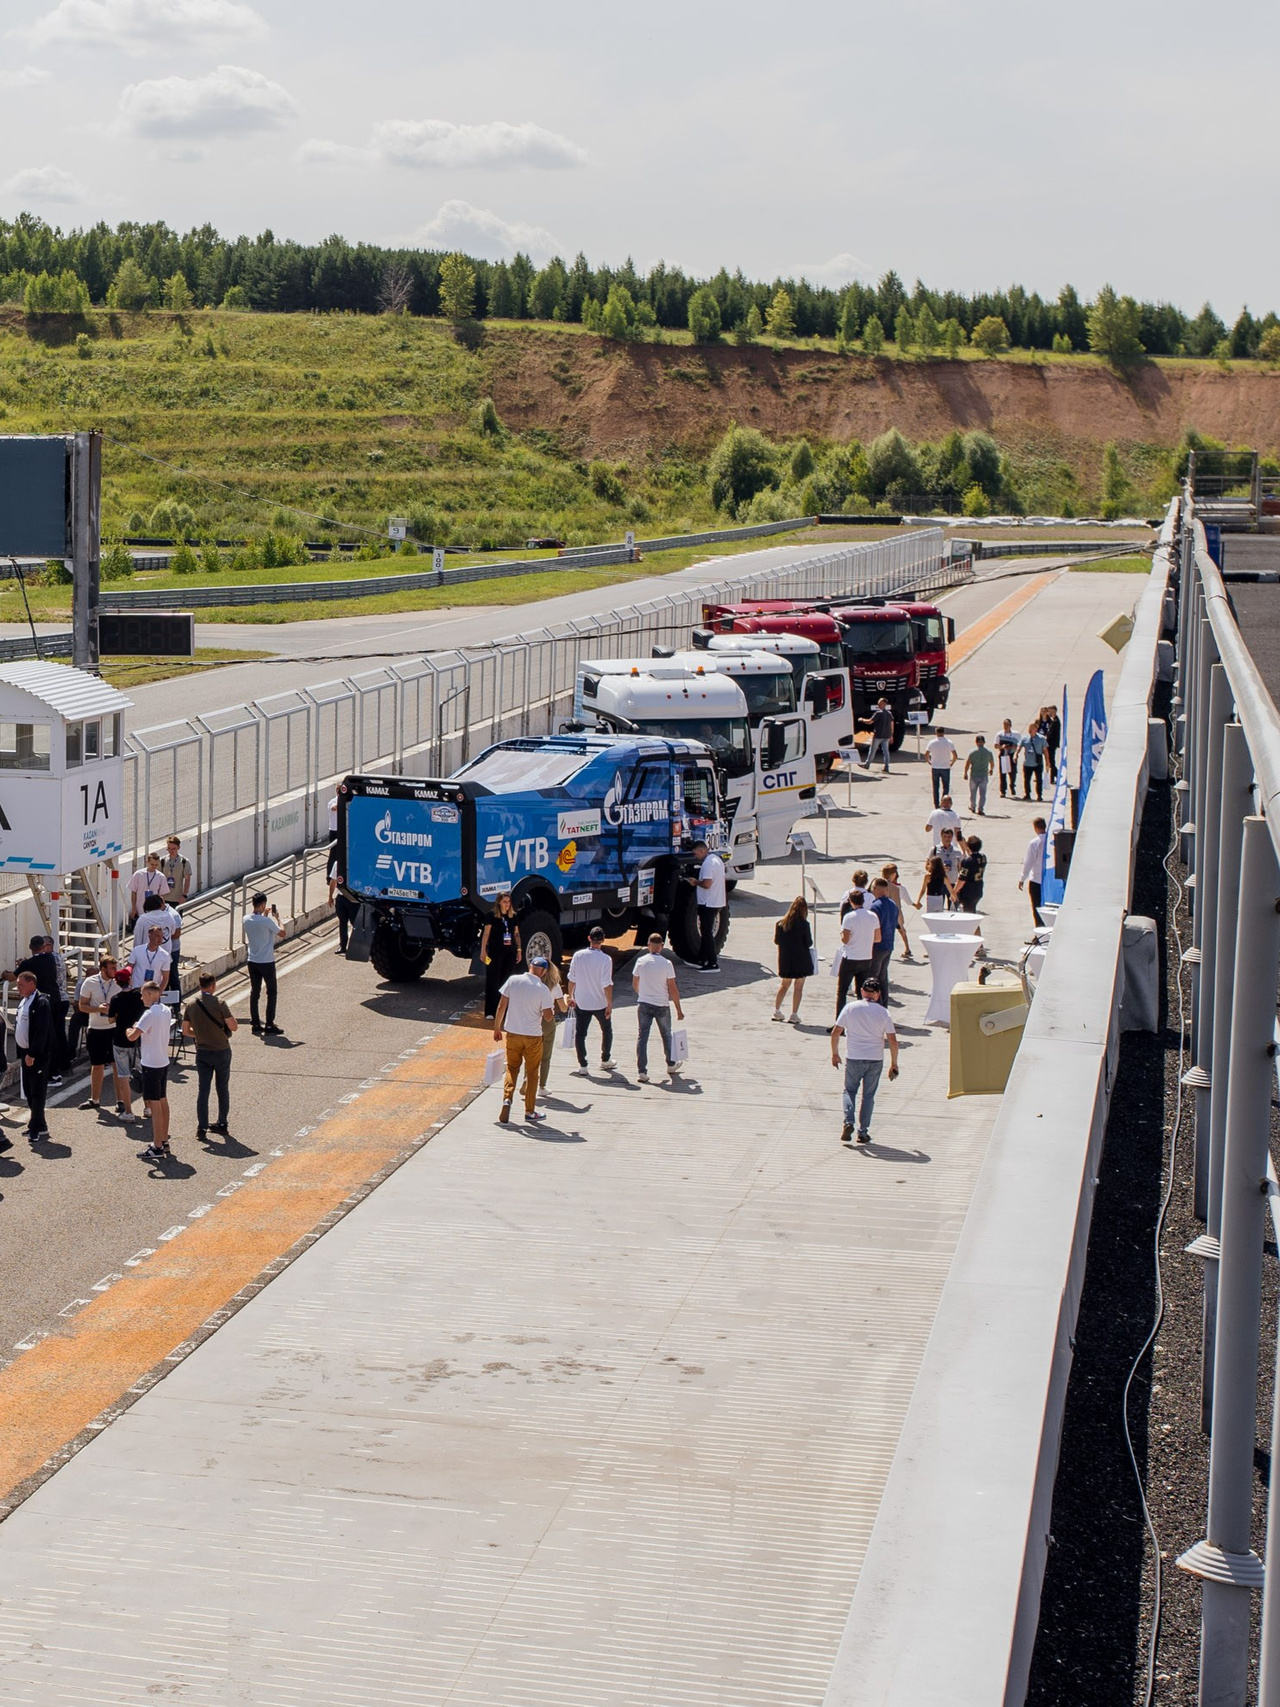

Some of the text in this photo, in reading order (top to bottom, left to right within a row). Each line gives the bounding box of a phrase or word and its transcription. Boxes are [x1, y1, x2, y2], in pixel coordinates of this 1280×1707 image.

[763, 771, 797, 790] СПГ
[80, 780, 109, 826] 1A
[366, 786, 439, 799] KAMAZ KAMAZ
[622, 799, 669, 825] ГАЗПРОМ
[391, 831, 433, 848] ГАЗПРОМ
[566, 823, 599, 835] TATNEFT
[505, 836, 549, 873] VTB
[393, 860, 433, 884] VTB
